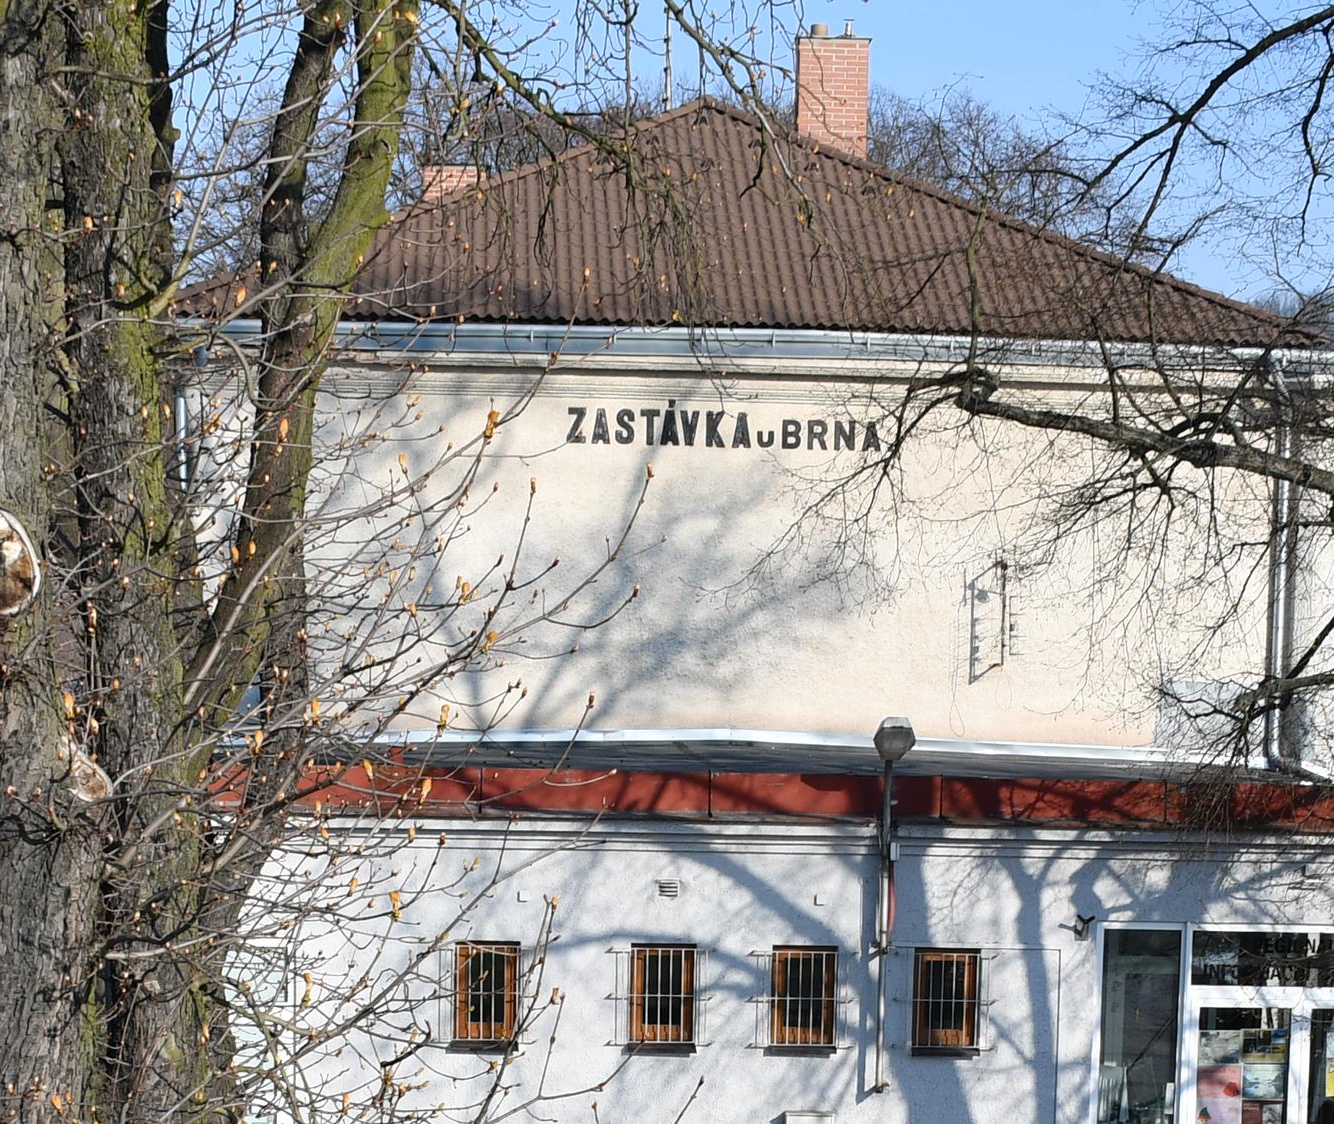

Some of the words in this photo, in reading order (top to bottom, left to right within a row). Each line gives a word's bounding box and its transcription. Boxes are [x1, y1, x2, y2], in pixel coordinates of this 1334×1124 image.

[567, 399, 751, 449] ZASTÁVKA
[781, 419, 881, 452] BRNA
[1203, 961, 1310, 981] INFOAČN
